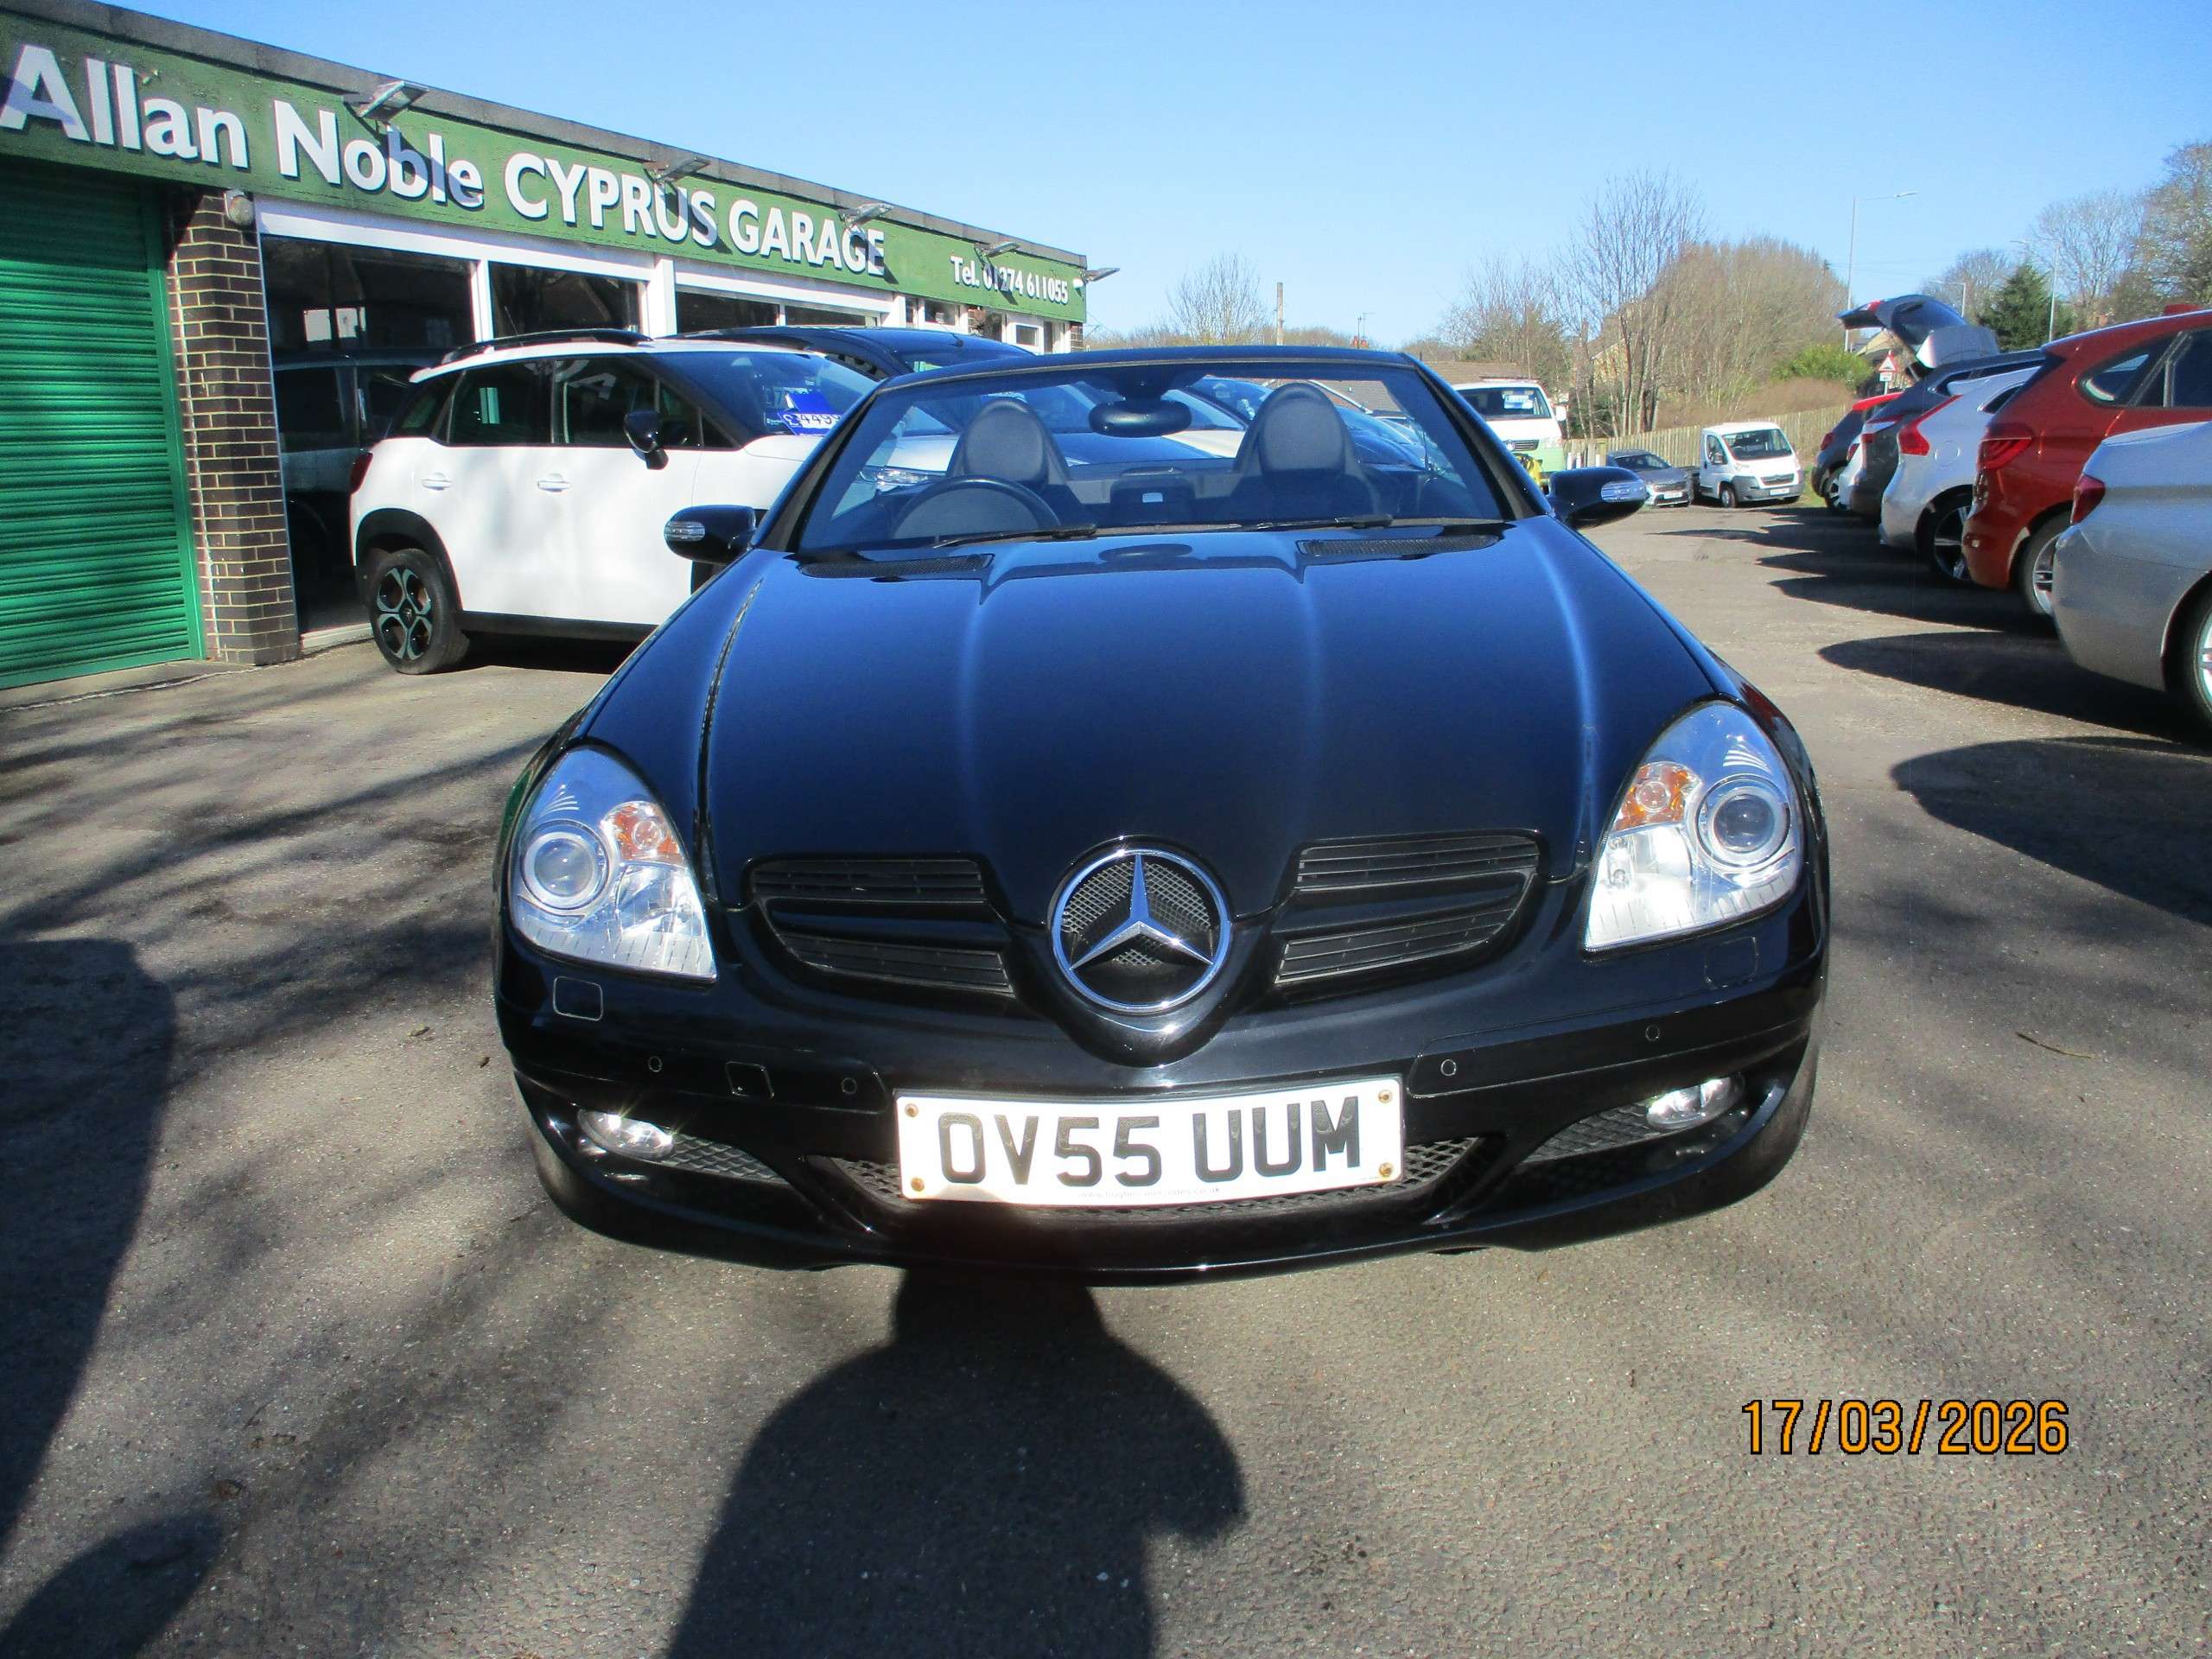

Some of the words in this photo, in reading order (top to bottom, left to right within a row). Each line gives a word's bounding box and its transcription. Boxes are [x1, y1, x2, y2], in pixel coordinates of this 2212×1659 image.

[0, 44, 249, 169] Allan
[274, 99, 485, 209] Noble
[504, 151, 718, 248] CYPRUS
[728, 199, 885, 276] GARAGE
[950, 256, 980, 288] Tel.
[982, 262, 1024, 296] 01274
[1027, 272, 1069, 305] 611055
[938, 1111, 1163, 1187] OV55
[1192, 1095, 1362, 1185] UUM
